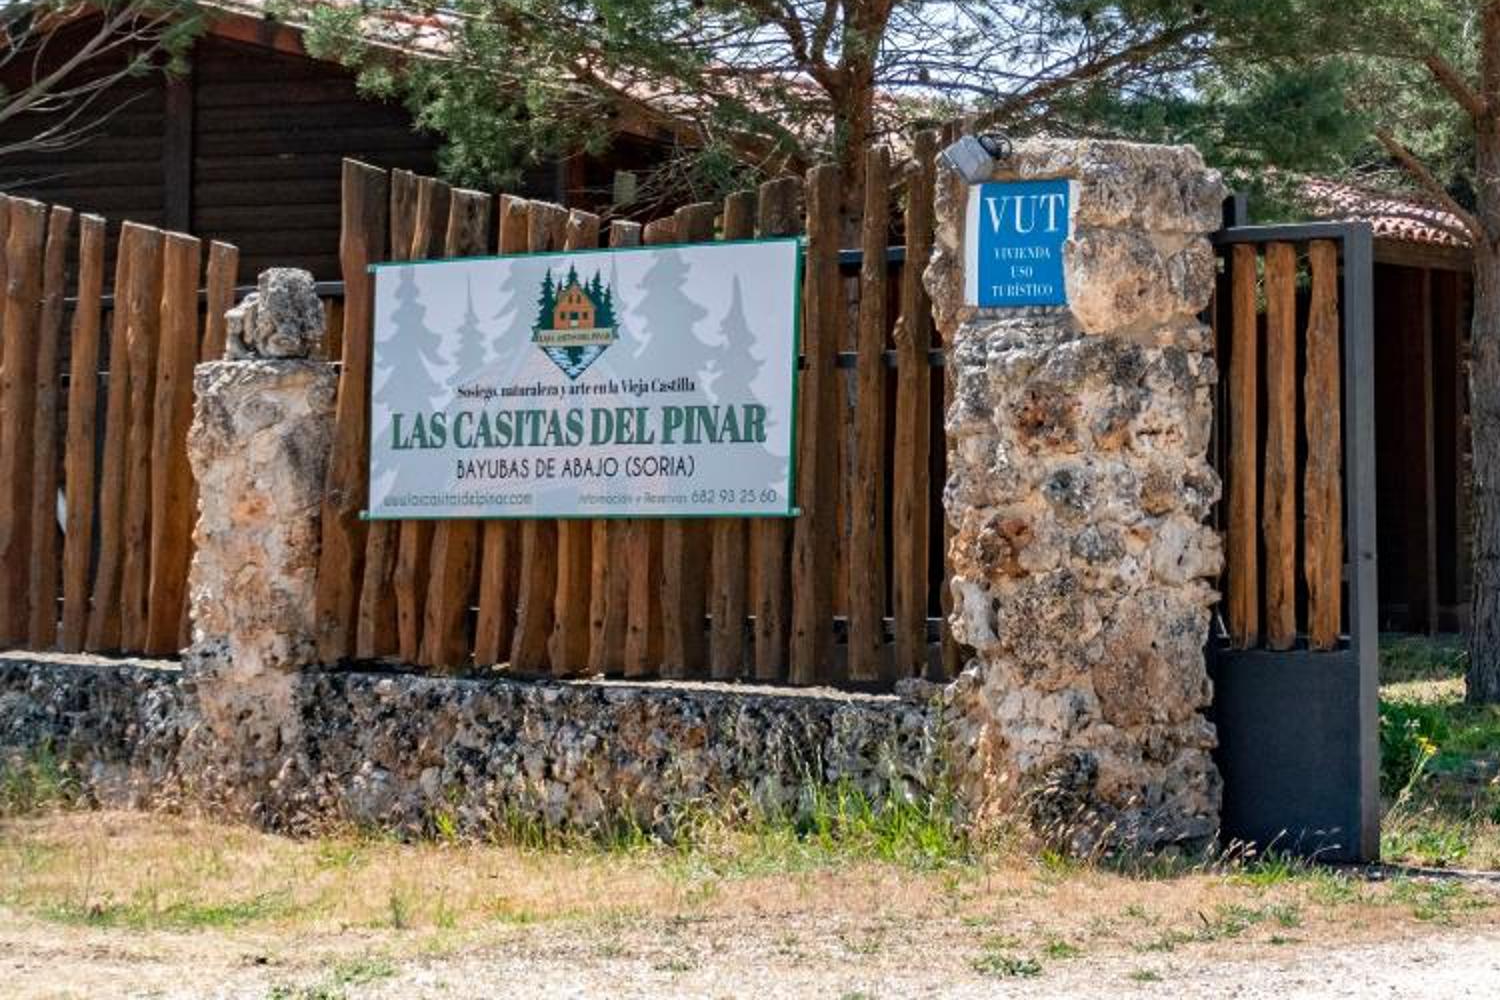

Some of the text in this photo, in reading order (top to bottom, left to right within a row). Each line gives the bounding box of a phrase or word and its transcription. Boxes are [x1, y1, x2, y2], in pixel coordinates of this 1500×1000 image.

[984, 193, 1065, 234] VUT
[994, 246, 1051, 260] VIVIENDA
[1010, 265, 1033, 279] USO
[992, 282, 1054, 297] TURÍSTICO
[501, 382, 559, 397] naturaleza
[559, 386, 566, 399] y
[570, 383, 591, 395] arte
[593, 385, 607, 395] en
[608, 380, 619, 394] la
[621, 379, 649, 397] Vieja
[651, 377, 696, 393] Castilla
[391, 404, 767, 450] LAS CASITAS DEL PINAR
[457, 455, 695, 479] BAYUBAS DE ABAJO (SORIA)
[691, 489, 714, 504] 682
[719, 489, 735, 503] 93
[739, 489, 756, 503] 25
[759, 488, 777, 503] 60
